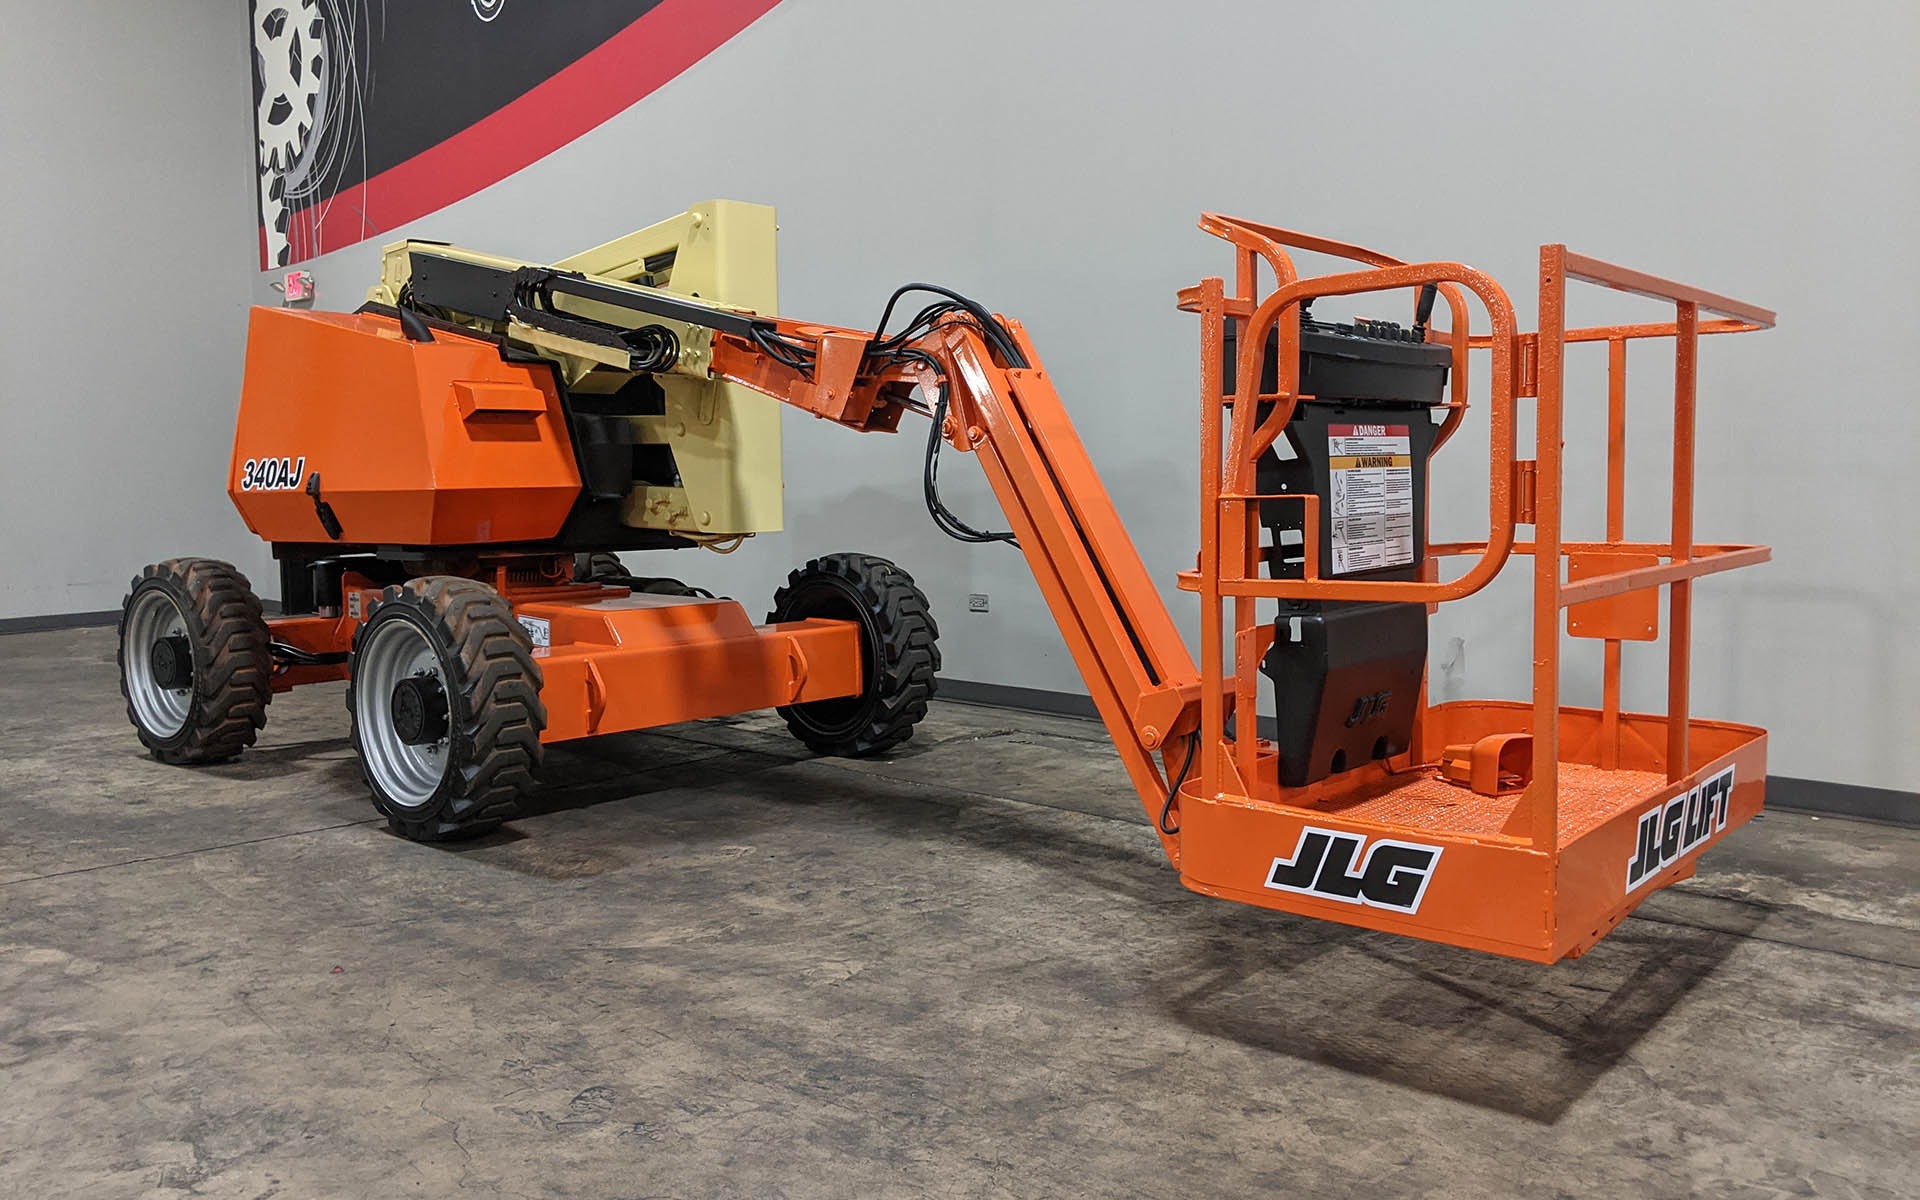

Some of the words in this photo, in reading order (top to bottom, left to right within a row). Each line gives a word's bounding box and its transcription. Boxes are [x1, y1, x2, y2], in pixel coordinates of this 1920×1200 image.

[1360, 424, 1386, 436] DANGER
[243, 458, 304, 489] 340AJ
[1362, 457, 1392, 468] WARNING
[1627, 795, 1686, 890] JLG
[1681, 766, 1734, 854] LIFT
[1268, 829, 1439, 911] JLG
